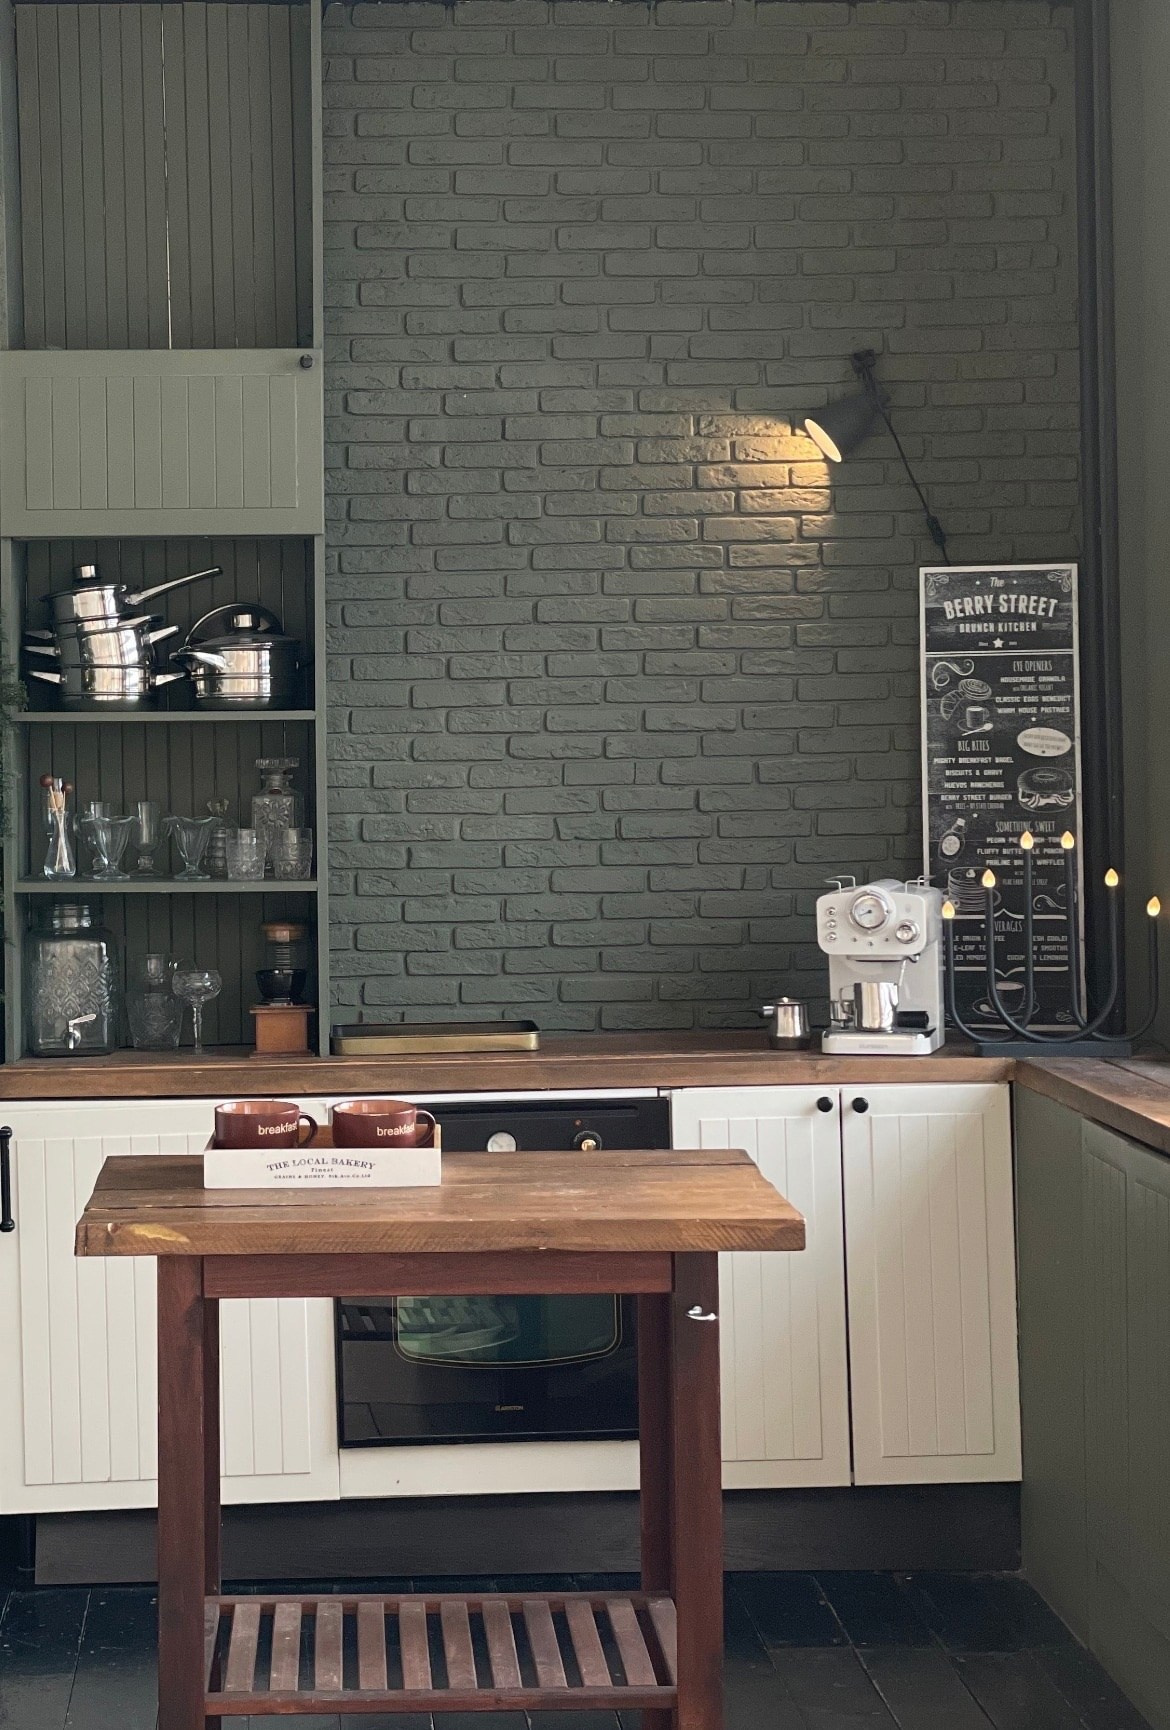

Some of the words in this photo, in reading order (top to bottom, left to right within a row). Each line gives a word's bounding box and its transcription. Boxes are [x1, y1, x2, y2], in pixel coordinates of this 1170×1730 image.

[990, 577, 1005, 588] The
[943, 595, 994, 620] BERRY
[999, 594, 1059, 618] STREET
[959, 622, 995, 633] BRUNCH
[998, 622, 1037, 633] KITCHEN
[1025, 660, 1053, 672] OPENERS
[958, 740, 970, 752] BIG
[972, 740, 990, 752] BITES
[1035, 821, 1056, 832] SWEET
[994, 920, 1023, 932] VERAGES
[258, 1120, 298, 1135] breakfast
[267, 1160, 290, 1171] THE
[292, 1158, 328, 1167] LOCAL
[331, 1158, 376, 1170] BAKERY
